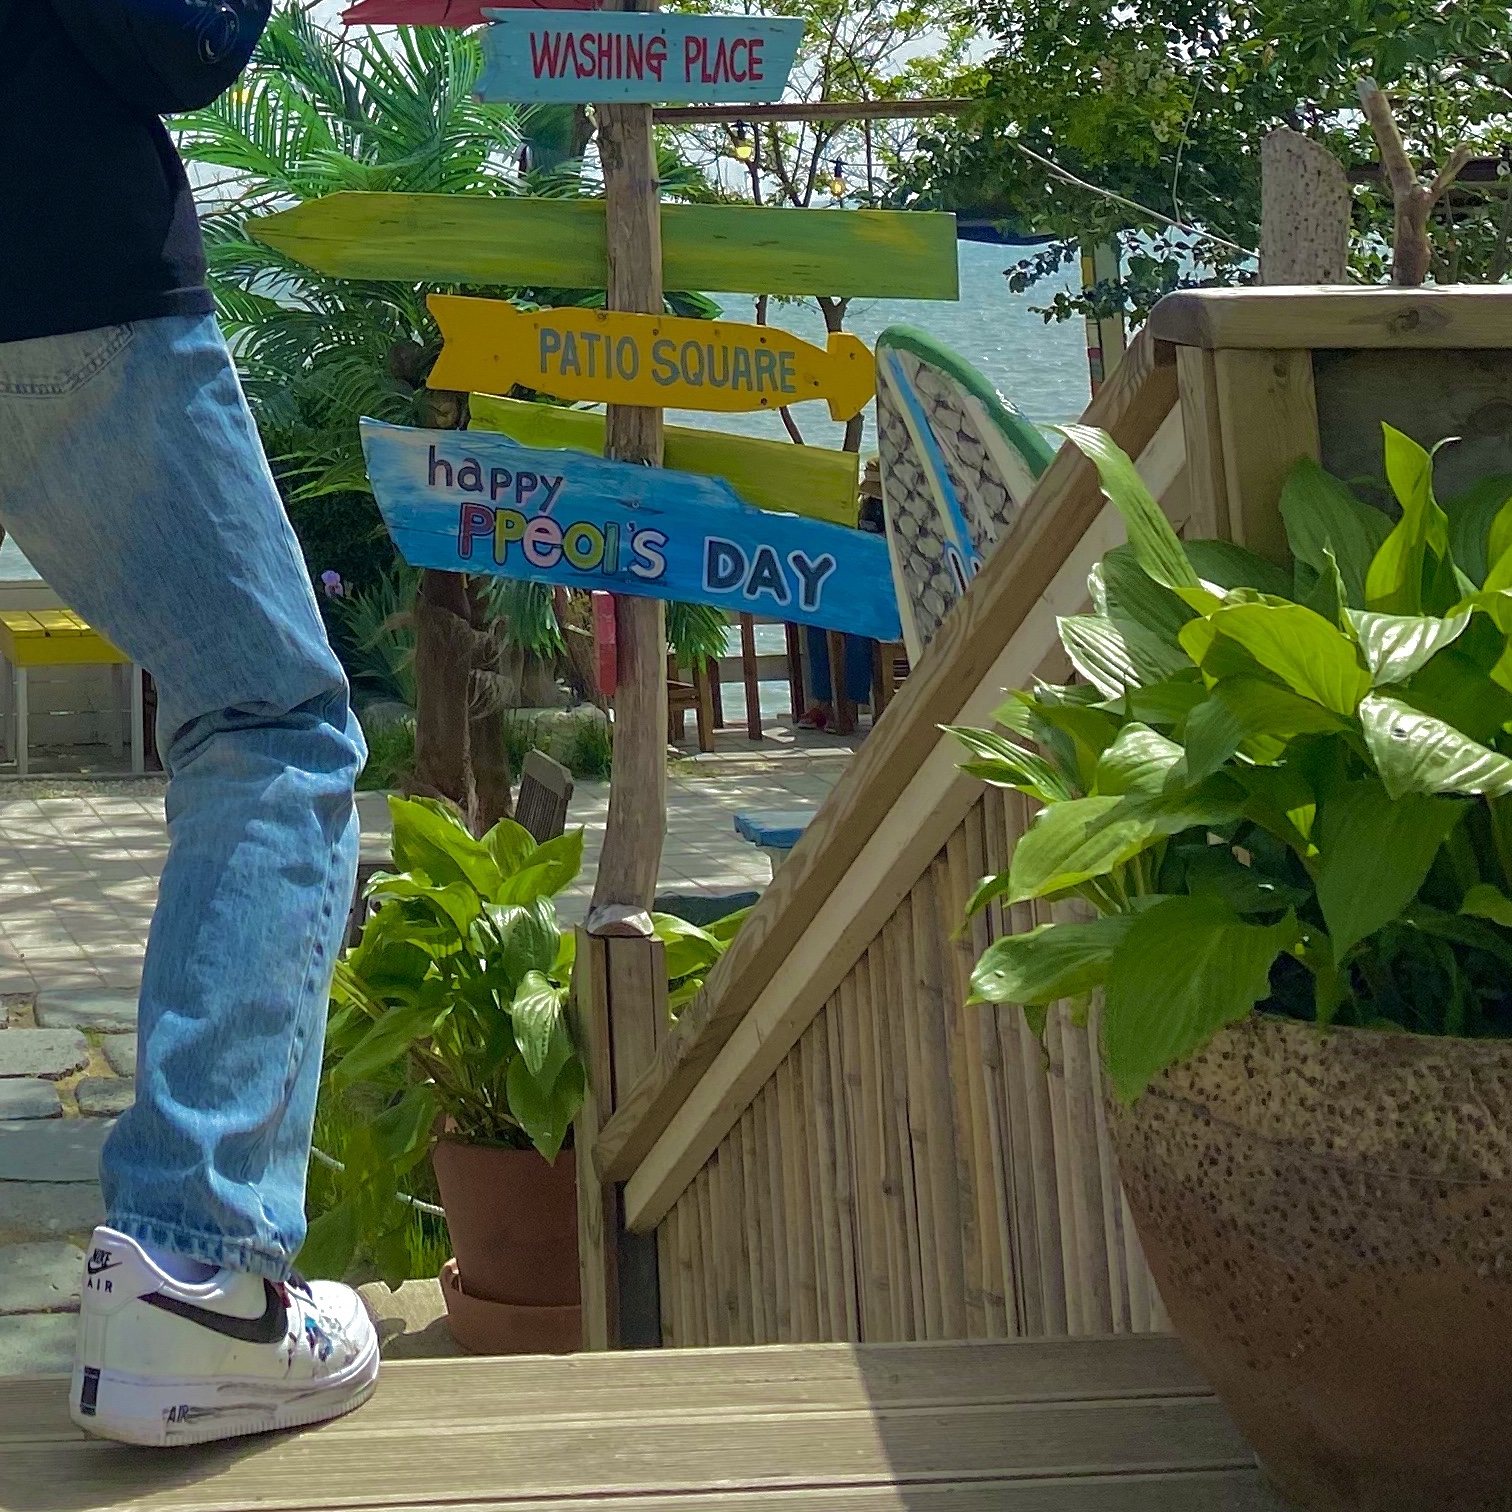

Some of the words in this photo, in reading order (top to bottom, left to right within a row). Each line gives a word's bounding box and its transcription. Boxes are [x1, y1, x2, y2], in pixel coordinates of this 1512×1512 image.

[530, 30, 668, 83] WASHING
[684, 36, 765, 84] PLACE
[540, 327, 639, 381] PATIO
[651, 339, 797, 394] SQUARE
[428, 445, 563, 514] happy
[702, 536, 836, 612] DAY
[88, 1277, 113, 1294] AIR
